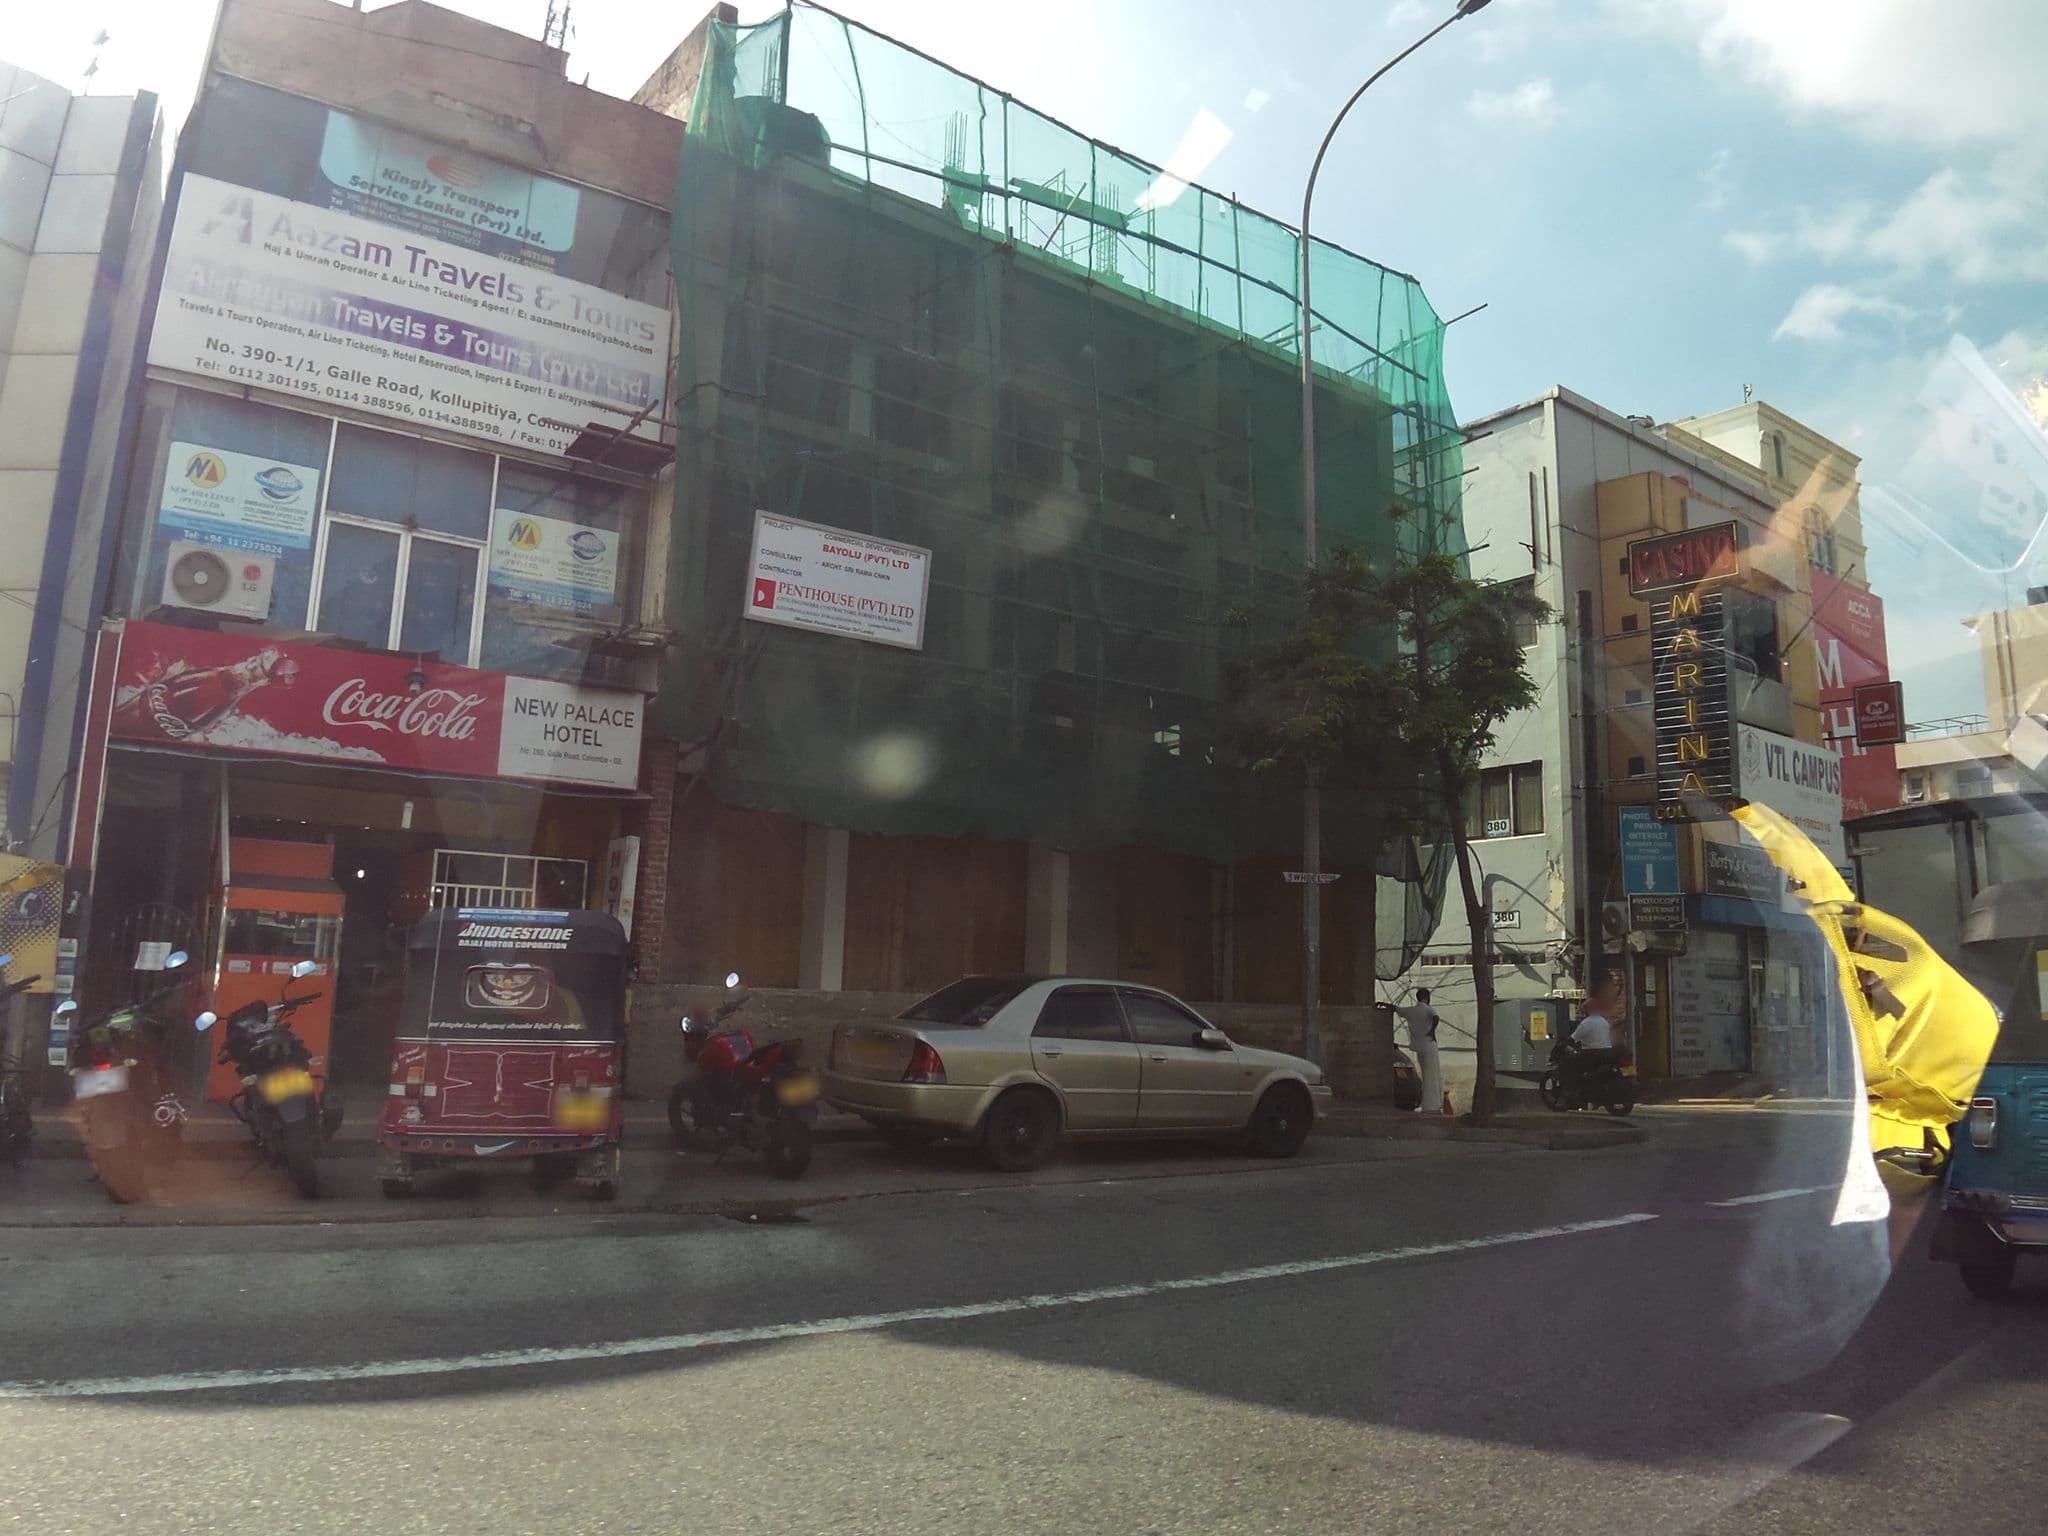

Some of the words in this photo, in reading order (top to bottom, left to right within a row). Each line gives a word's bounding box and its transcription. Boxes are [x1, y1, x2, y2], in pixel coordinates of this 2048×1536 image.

[349, 174, 409, 202] Service
[414, 194, 466, 219] Lanka
[470, 210, 511, 235] (Pvt)
[515, 225, 545, 245] Ltd.
[382, 167, 437, 194] Kingly
[441, 186, 519, 220] Transport
[264, 241, 281, 256] Haj
[296, 249, 330, 267] Umrah
[333, 259, 379, 279] Operator
[381, 271, 389, 282] &
[392, 275, 406, 287] Air
[409, 280, 430, 293] Line
[433, 286, 479, 308] Ticketing
[481, 300, 509, 315] Agent
[267, 209, 393, 268] Aazam
[404, 244, 525, 303] Travels
[535, 285, 560, 312] &
[570, 294, 656, 342] Tours
[179, 298, 214, 316] Travels
[216, 307, 224, 317] &
[227, 309, 253, 325] Tours
[256, 316, 306, 338] Operators,
[308, 328, 321, 341] Air
[323, 331, 344, 347] Line
[346, 337, 391, 358] Ticketing,
[393, 349, 417, 364] Hotel
[418, 355, 474, 379] Reservation,
[475, 370, 504, 386] Import
[505, 376, 512, 387] &
[514, 379, 543, 396] Export
[331, 296, 427, 340] Travels
[433, 322, 455, 346] &
[461, 329, 533, 371] Tours
[205, 336, 235, 355] No.
[241, 344, 322, 377] 390-1/1,
[327, 364, 372, 387] Galle
[376, 375, 424, 400] Road,
[429, 388, 522, 424] Kollupitiya,
[195, 356, 221, 372] Tel:
[228, 364, 263, 381] 0112
[266, 373, 322, 396] 301195,
[326, 386, 359, 402] 0114
[362, 394, 415, 416] 388596,
[520, 431, 545, 448] Fax:
[764, 520, 793, 532] PROJECT
[760, 548, 803, 563] CONSULTANT
[822, 544, 862, 560] BAYOLU
[864, 551, 890, 567] (PVT)
[892, 560, 910, 570] LTD
[823, 533, 864, 548] COMMERCIAL
[865, 542, 908, 557] DEVELOPMENT
[909, 552, 921, 560] FOR
[758, 563, 803, 577] CONTRACTOR
[777, 581, 855, 608] PENTHOUSE
[857, 597, 888, 615] (PVT)
[890, 606, 914, 619] LTD
[1669, 592, 1708, 796] MARINA
[513, 696, 559, 718] NEW
[564, 703, 635, 729] PALACE
[543, 723, 603, 747] HOTEL
[1765, 742, 1790, 782] VTL
[1792, 750, 1841, 796] CAMPUS
[1487, 821, 1507, 832] 380
[458, 920, 574, 941] BRIDGESTONE
[1494, 912, 1515, 922] 380
[458, 939, 483, 947] BAJAJ
[484, 940, 513, 948] MOTOR
